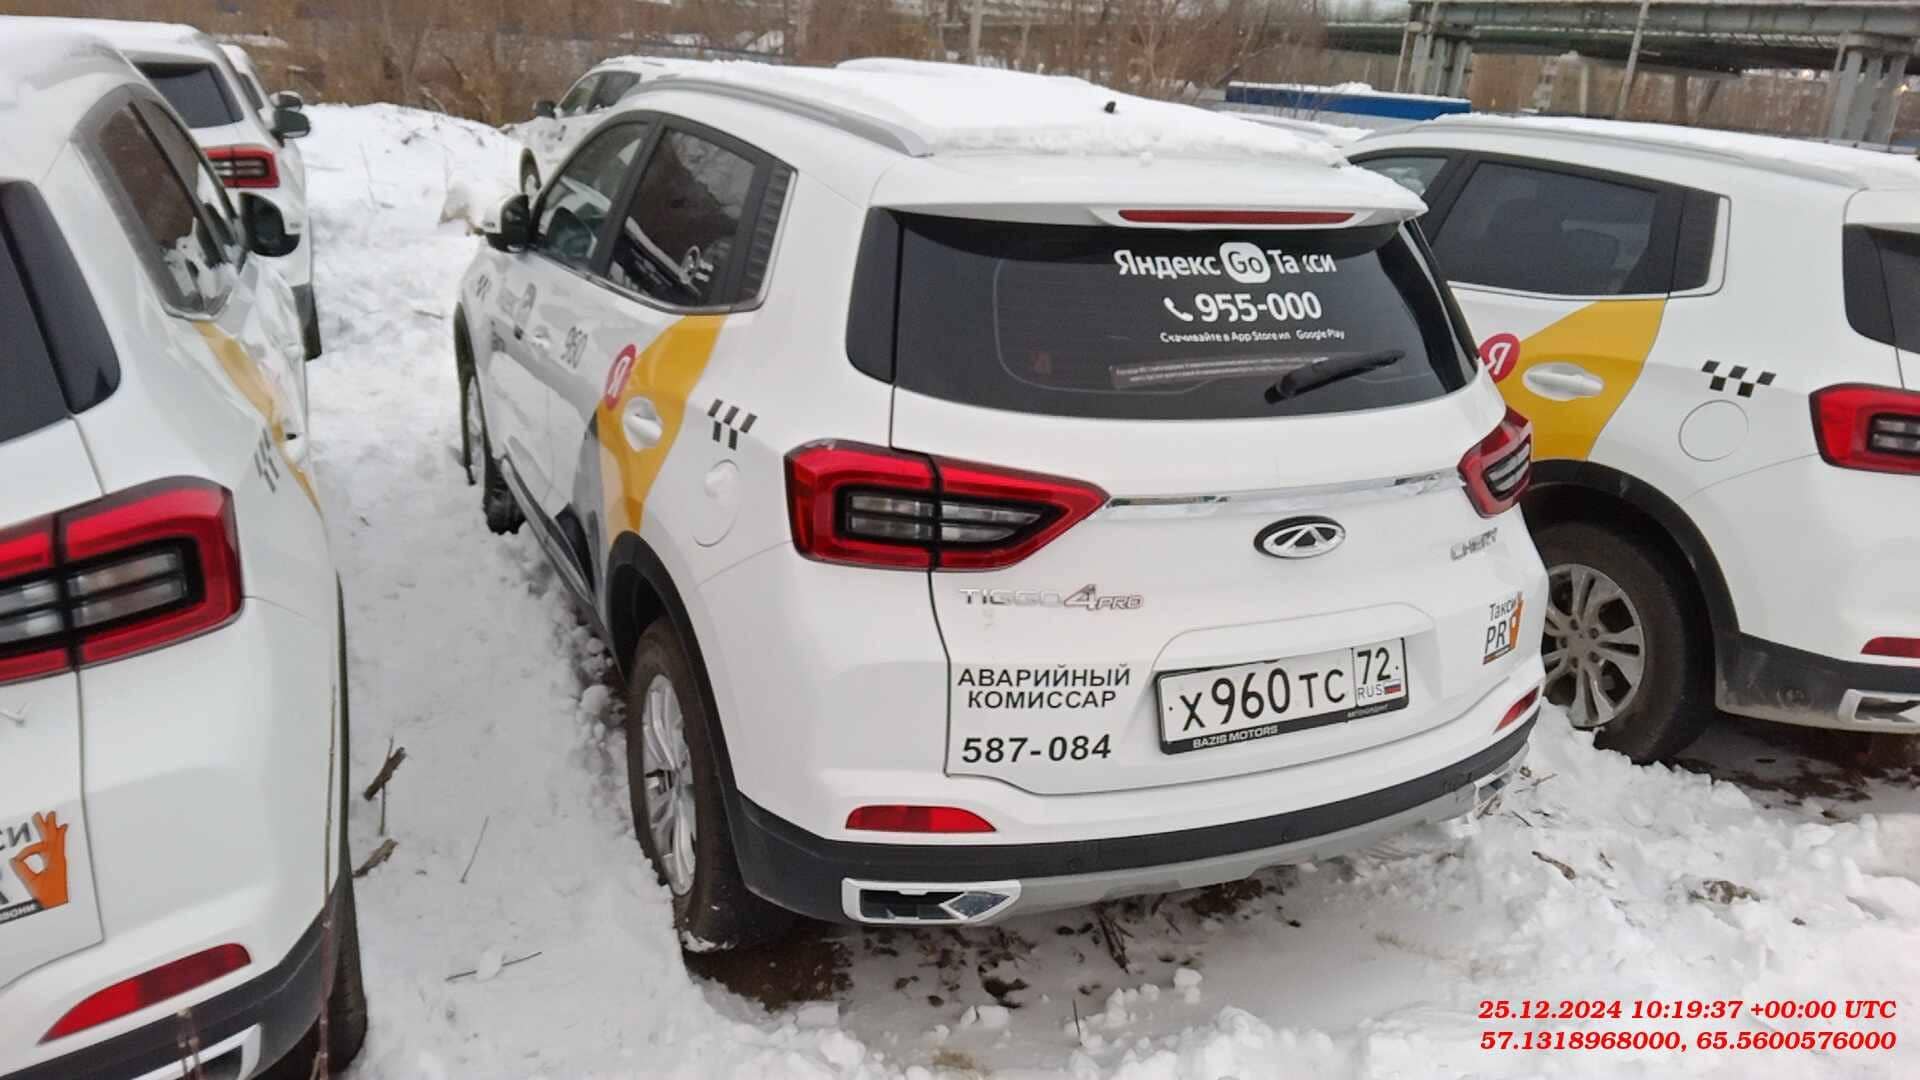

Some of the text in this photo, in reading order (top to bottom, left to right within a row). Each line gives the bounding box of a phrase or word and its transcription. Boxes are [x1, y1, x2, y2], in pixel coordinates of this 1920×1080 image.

[1113, 250, 1221, 279] Яндекс
[1194, 291, 1323, 322] 955-000
[1231, 331, 1251, 343] App
[1252, 331, 1277, 342] Store
[1296, 329, 1327, 341] Google
[1327, 328, 1345, 340] Play
[958, 664, 1131, 687] АВАРИЙНЫЙ
[1357, 647, 1392, 685] 72
[968, 690, 1117, 709] КОМИССАР
[1357, 683, 1382, 699] RUS
[962, 734, 1111, 763] 587-084
[1193, 724, 1279, 749] BAZIS MOTORS
